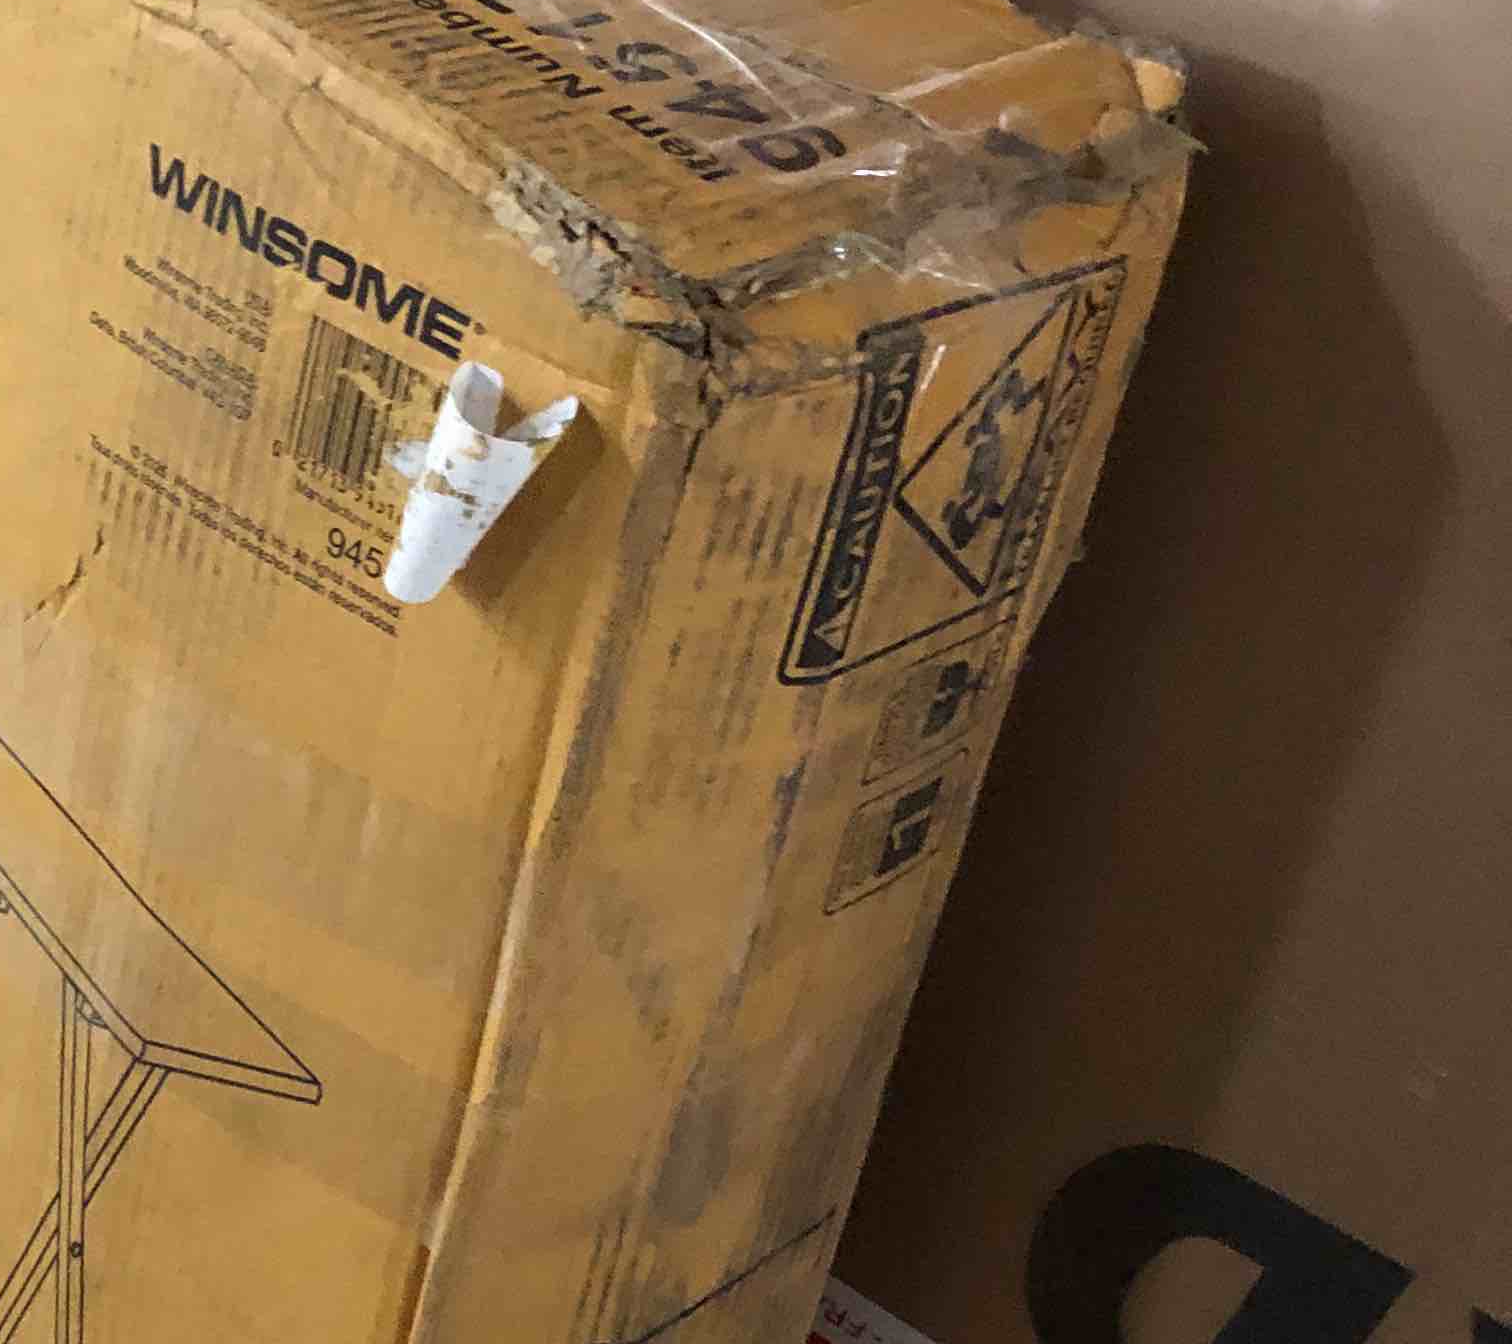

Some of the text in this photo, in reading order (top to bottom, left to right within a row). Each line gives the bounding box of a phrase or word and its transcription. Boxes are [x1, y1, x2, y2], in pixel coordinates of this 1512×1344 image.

[609, 103, 738, 182] Item
[149, 143, 472, 360] WINSOME
[832, 353, 914, 599] CAUTION
